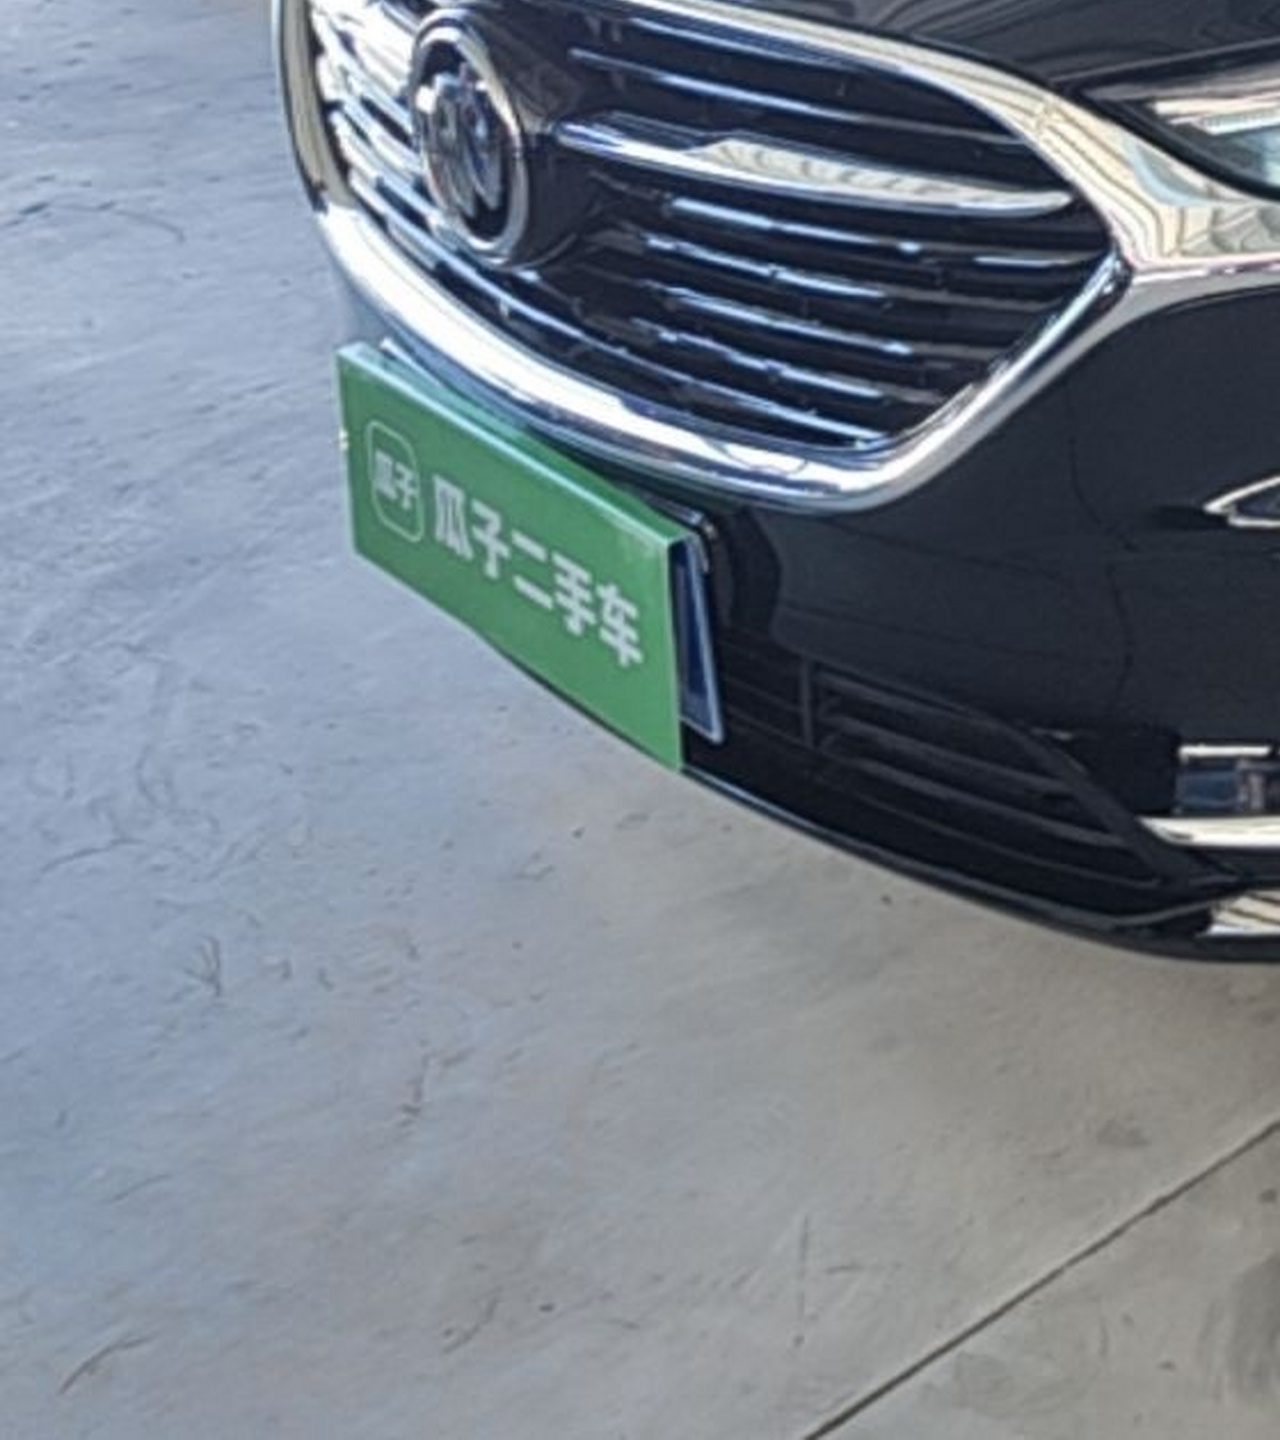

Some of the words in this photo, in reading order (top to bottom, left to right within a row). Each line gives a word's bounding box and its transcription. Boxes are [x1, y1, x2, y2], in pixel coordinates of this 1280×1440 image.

[433, 474, 644, 668] 瓜子二手车
